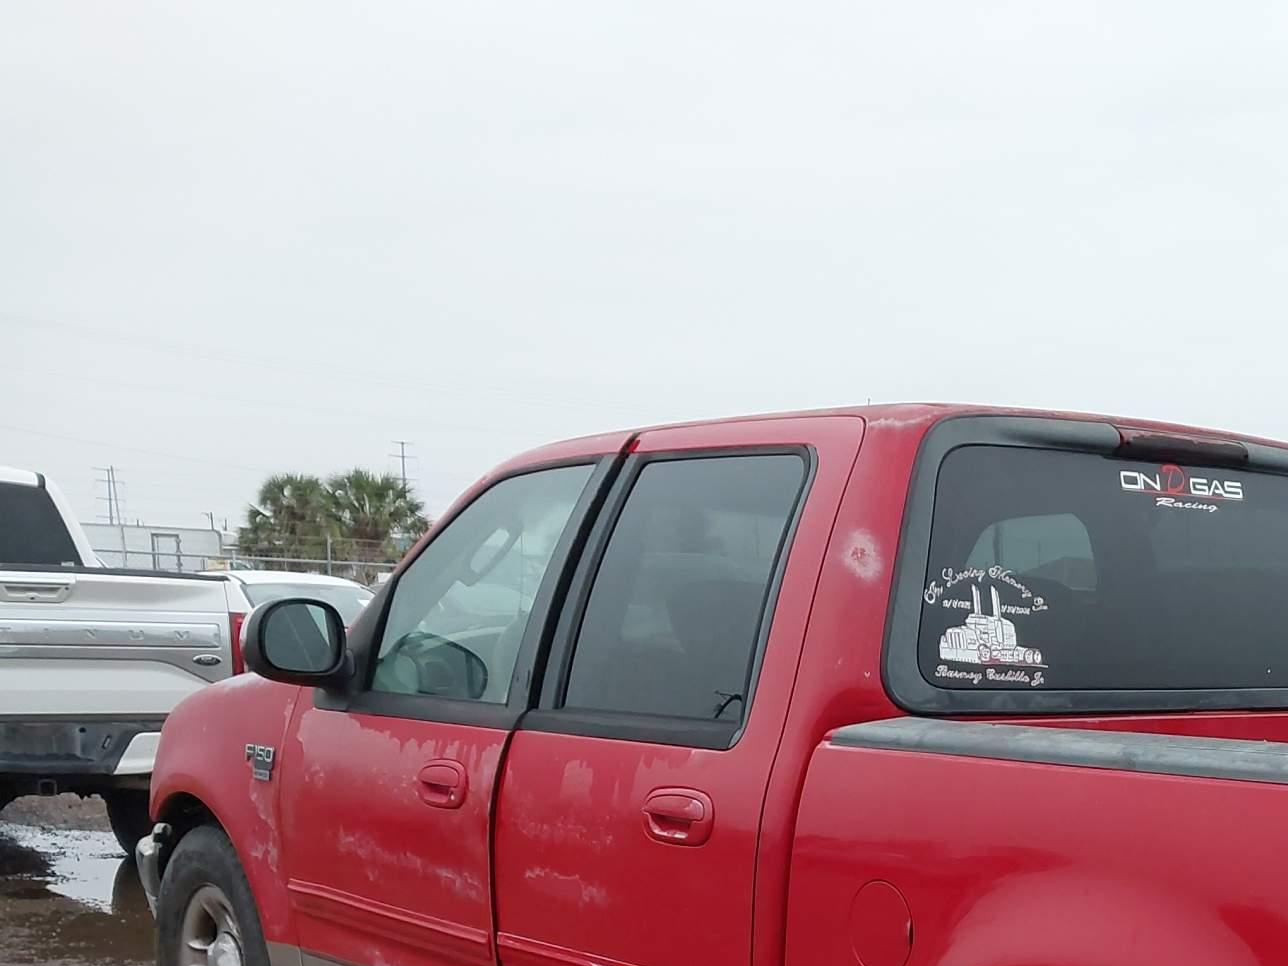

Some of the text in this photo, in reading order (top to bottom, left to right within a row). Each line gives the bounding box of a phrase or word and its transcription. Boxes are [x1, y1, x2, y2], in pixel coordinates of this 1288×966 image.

[1120, 470, 1161, 491] ON
[1189, 477, 1244, 499] GAS
[1155, 497, 1219, 513] Racing
[942, 567, 987, 588] Loving
[988, 565, 1033, 598] Memory
